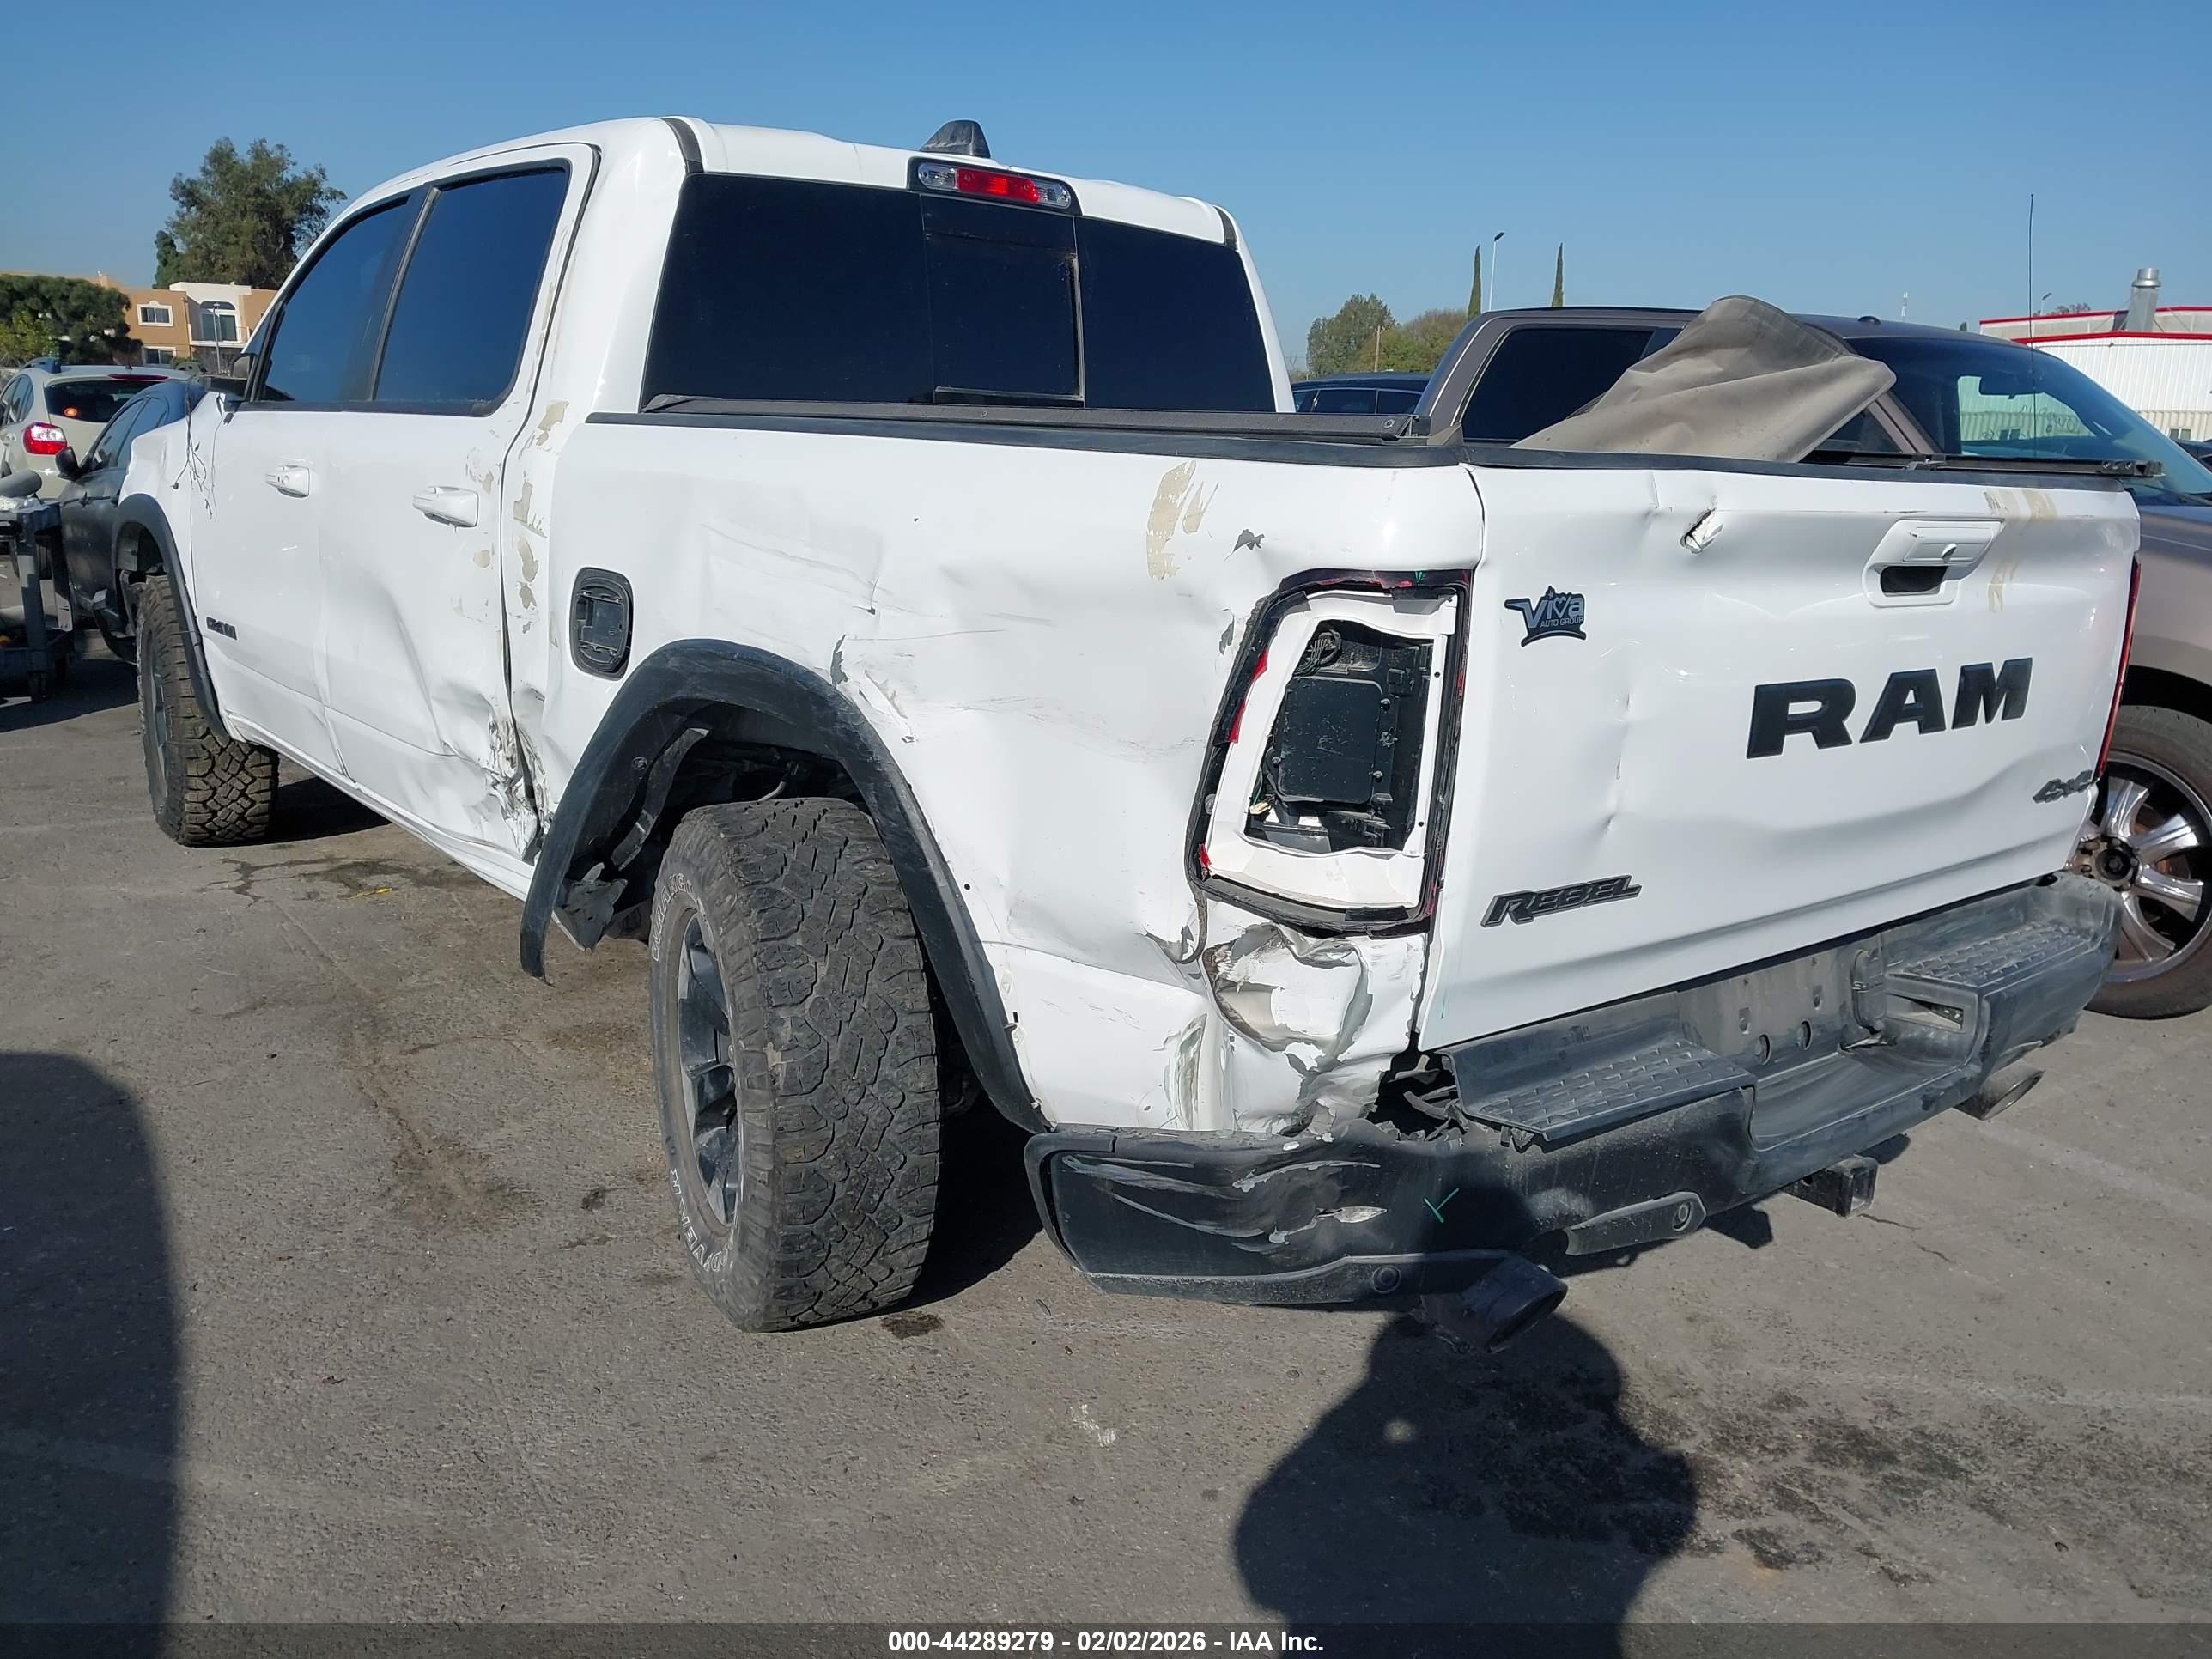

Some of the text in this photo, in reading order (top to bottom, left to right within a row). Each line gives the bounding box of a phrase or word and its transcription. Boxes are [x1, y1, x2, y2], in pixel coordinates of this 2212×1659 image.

[1540, 617, 1583, 628] AUTO GROUP
[1746, 657, 2033, 759] RAM
[1480, 874, 1642, 928] REBEL
